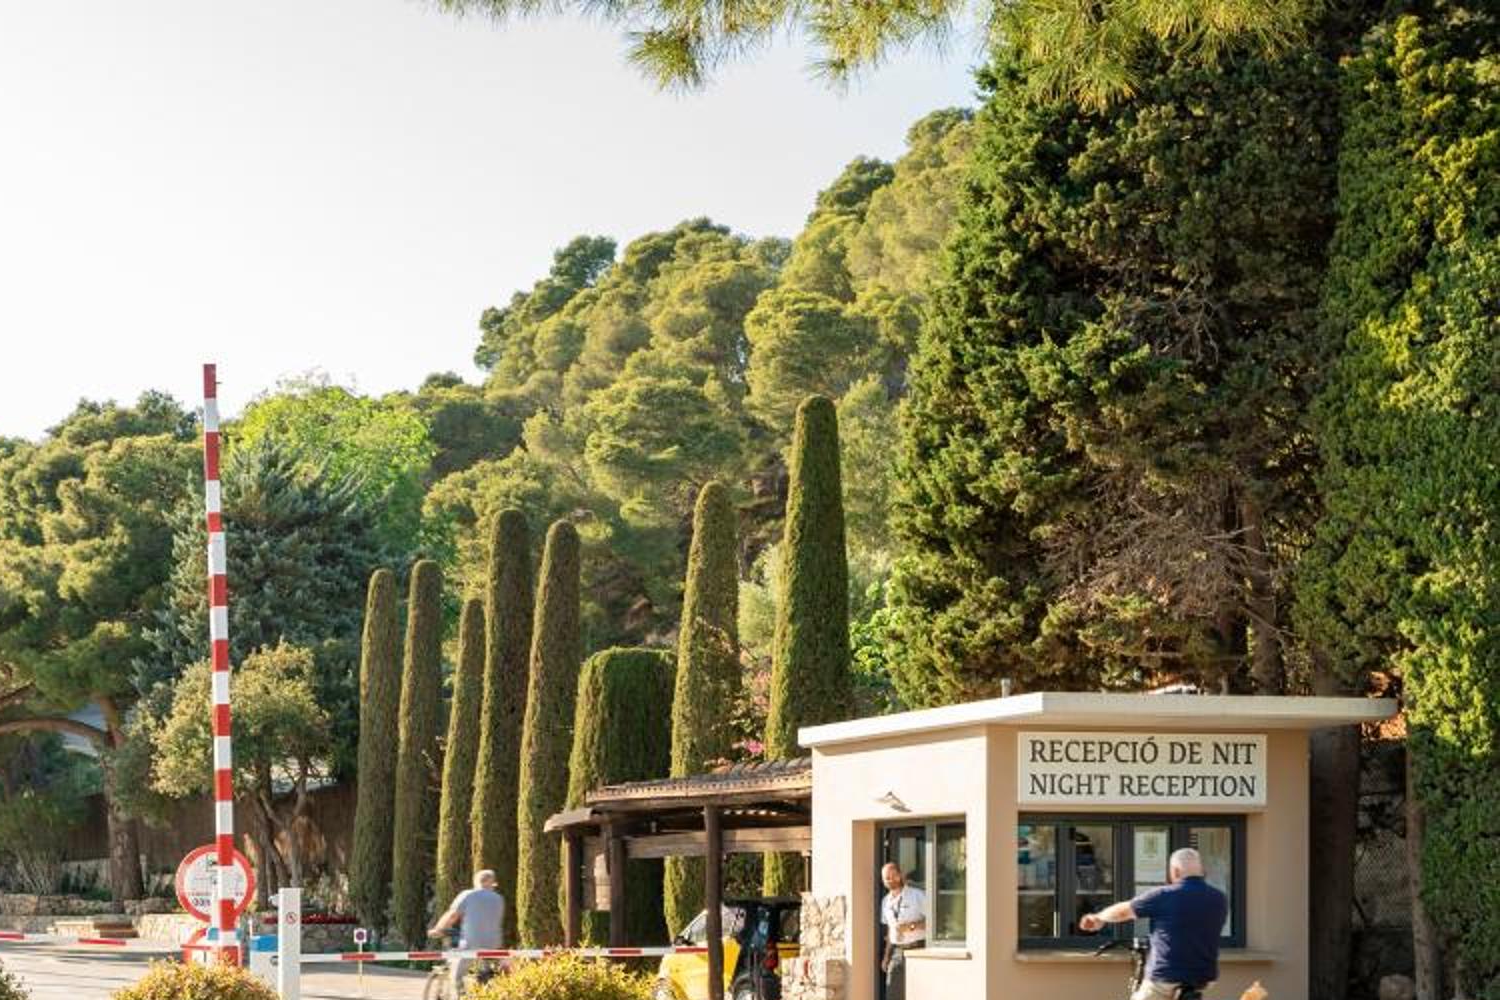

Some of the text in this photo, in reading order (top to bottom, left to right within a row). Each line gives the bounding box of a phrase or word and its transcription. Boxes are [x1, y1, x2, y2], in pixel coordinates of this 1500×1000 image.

[1029, 736, 1257, 766] RECEPCIÓ DE NIT
[1029, 773, 1256, 798] NIGHT RECEPTION
